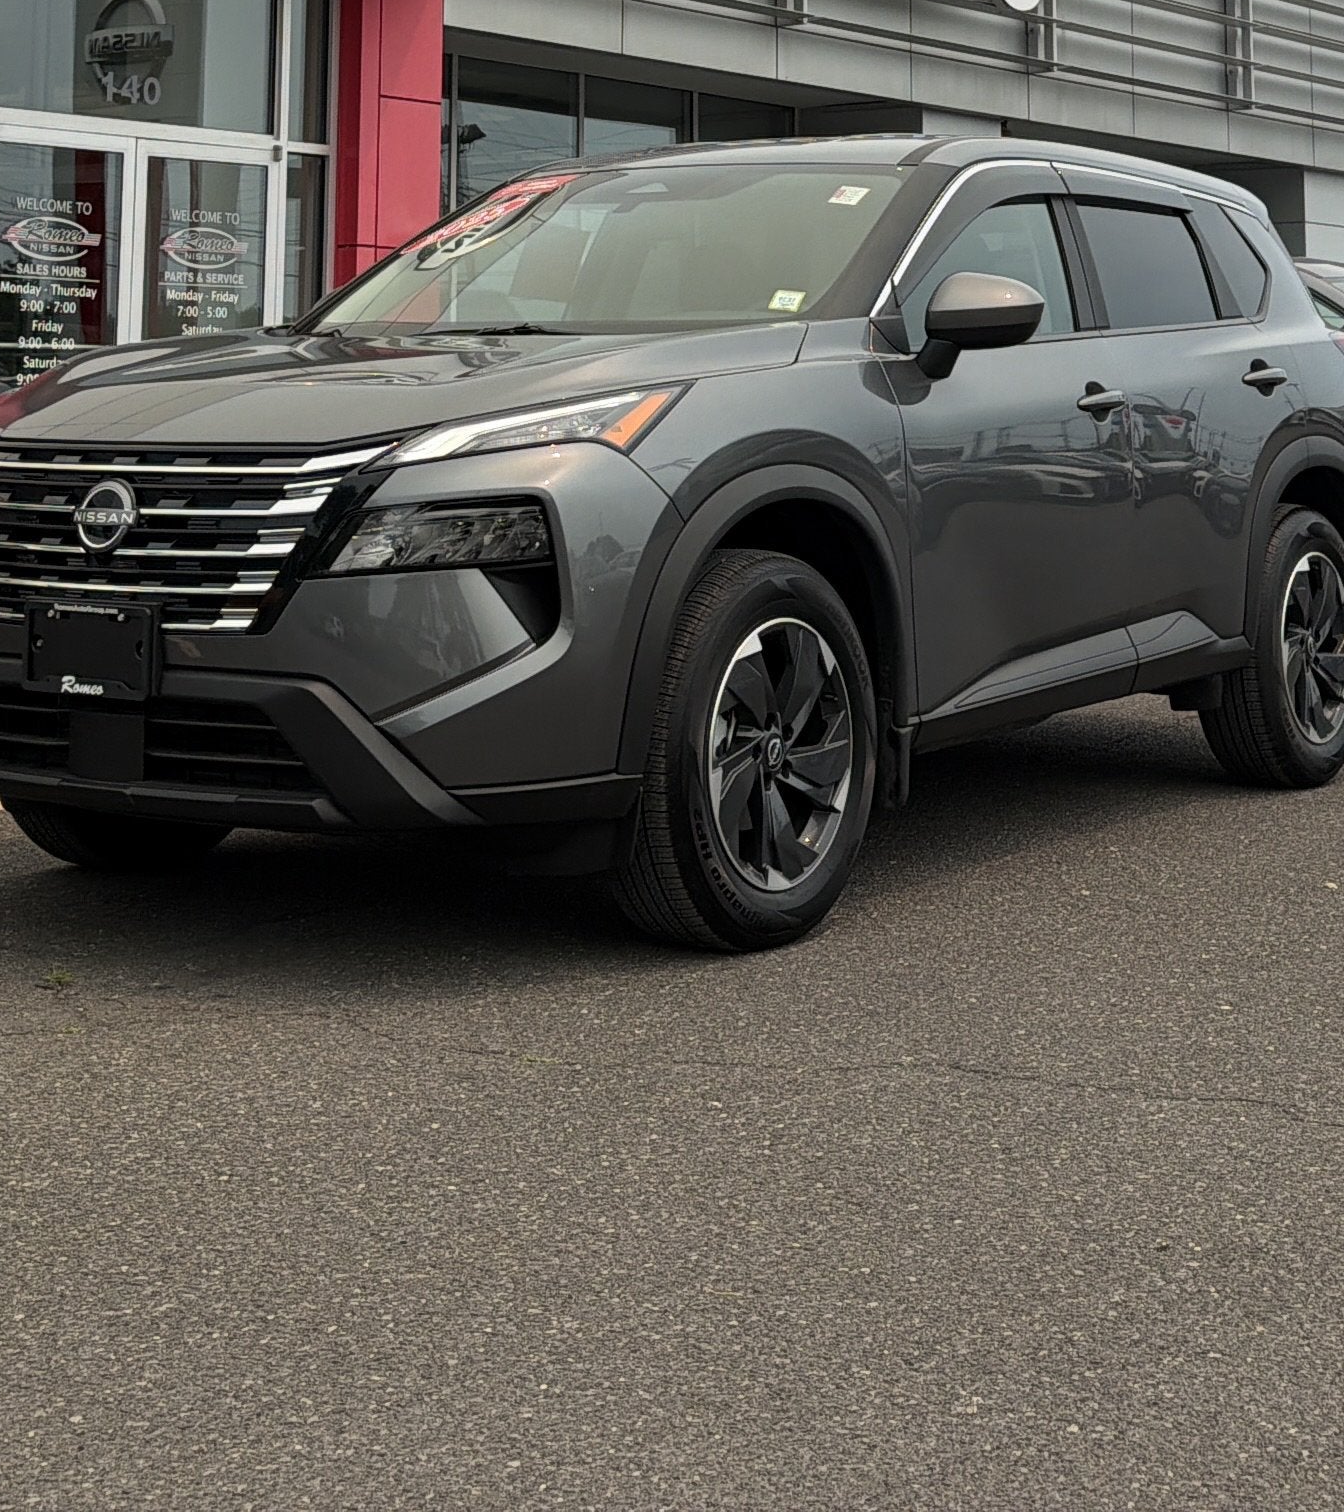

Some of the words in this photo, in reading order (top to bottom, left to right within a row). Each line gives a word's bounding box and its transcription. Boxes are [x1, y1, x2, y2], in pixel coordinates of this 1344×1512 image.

[102, 71, 161, 105] 140
[16, 196, 73, 214] WELCOME
[75, 201, 93, 216] TO
[171, 208, 223, 224] WELCOME
[225, 211, 240, 225] TO
[22, 218, 86, 242] Romeo
[179, 229, 236, 250] Romeo
[29, 242, 75, 254] NISSAN
[184, 251, 225, 262] NISSAN
[16, 263, 49, 276] SALES
[51, 265, 87, 278] HOURS
[164, 270, 194, 283] PARTS
[196, 272, 204, 283] &
[205, 273, 244, 285] SERVICE
[0, 280, 42, 297] Monday
[50, 283, 98, 300] Thursday
[166, 288, 203, 303] Monday
[211, 290, 239, 304] Friday
[19, 299, 44, 312] 9:00
[53, 301, 77, 314] 7:00
[177, 305, 199, 317] 7:00
[206, 306, 228, 319] 5:00
[31, 319, 64, 335] Friday
[18, 336, 43, 349] 9:00
[51, 337, 75, 350] 6:00
[22, 355, 65, 369] Saturd
[73, 510, 134, 524] NISSAN
[60, 675, 104, 696] Romeo
